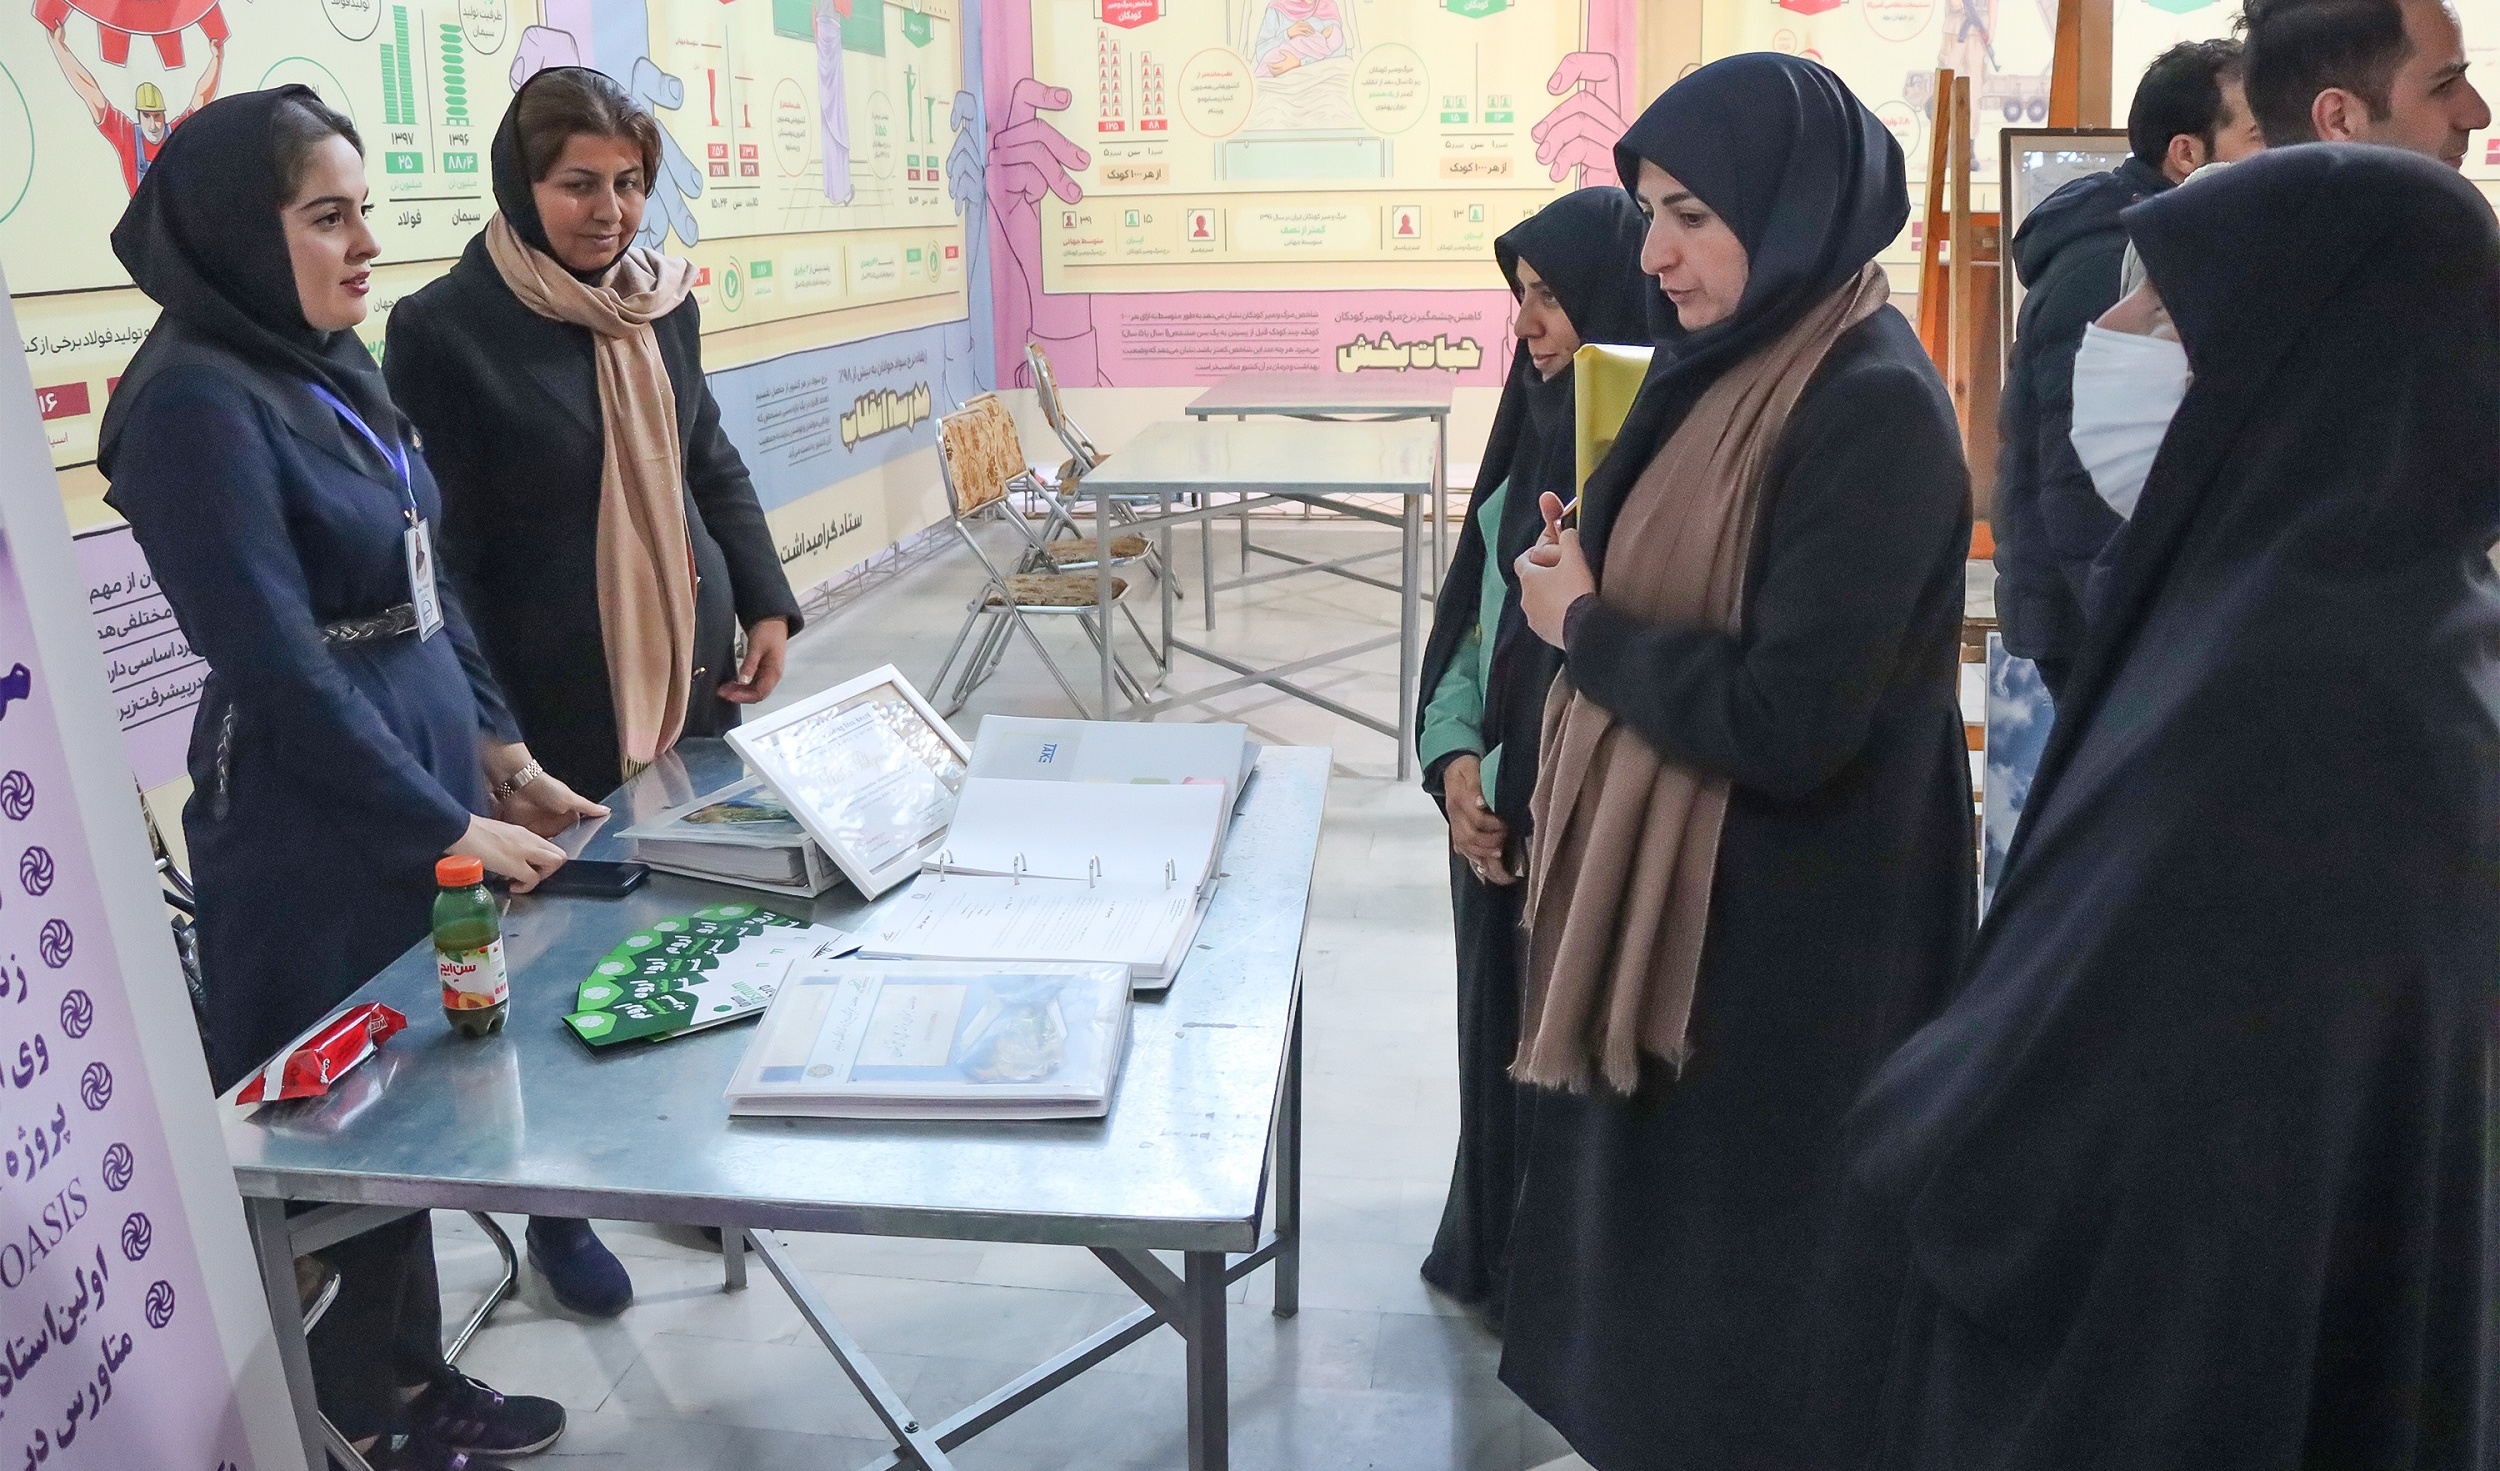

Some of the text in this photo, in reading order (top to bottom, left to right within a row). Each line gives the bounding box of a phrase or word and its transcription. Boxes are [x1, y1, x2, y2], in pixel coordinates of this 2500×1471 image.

[473, 25, 495, 37] سیمان
[1149, 121, 1160, 129] ۸۸
[391, 133, 414, 146] ۱۳۹۷
[449, 133, 470, 147] ۱۳۹۶
[398, 156, 413, 169] ۲۵
[1449, 163, 1474, 173] کودک
[1488, 164, 1500, 173] هر
[1107, 169, 1130, 181] کودک
[1143, 171, 1155, 180] هر
[1156, 168, 1162, 180] از
[398, 209, 422, 228] فولاد
[452, 206, 481, 226] سیمان
[1143, 214, 1153, 224] ۱۵
[1335, 311, 1365, 323] کودکان
[1454, 311, 1483, 323] کاهش
[40, 326, 144, 356] تولید فولاد برخی از
[839, 512, 863, 538] ستاد
[126, 571, 136, 594] از
[117, 607, 173, 638] مختلفی
[128, 641, 176, 675] اساسی
[12, 1034, 49, 1090] وی
[6, 1102, 71, 1183] پروژه
[0, 1177, 90, 1289] OASIS
[59, 1243, 109, 1346] اولین
[56, 1332, 133, 1450] متاورس
